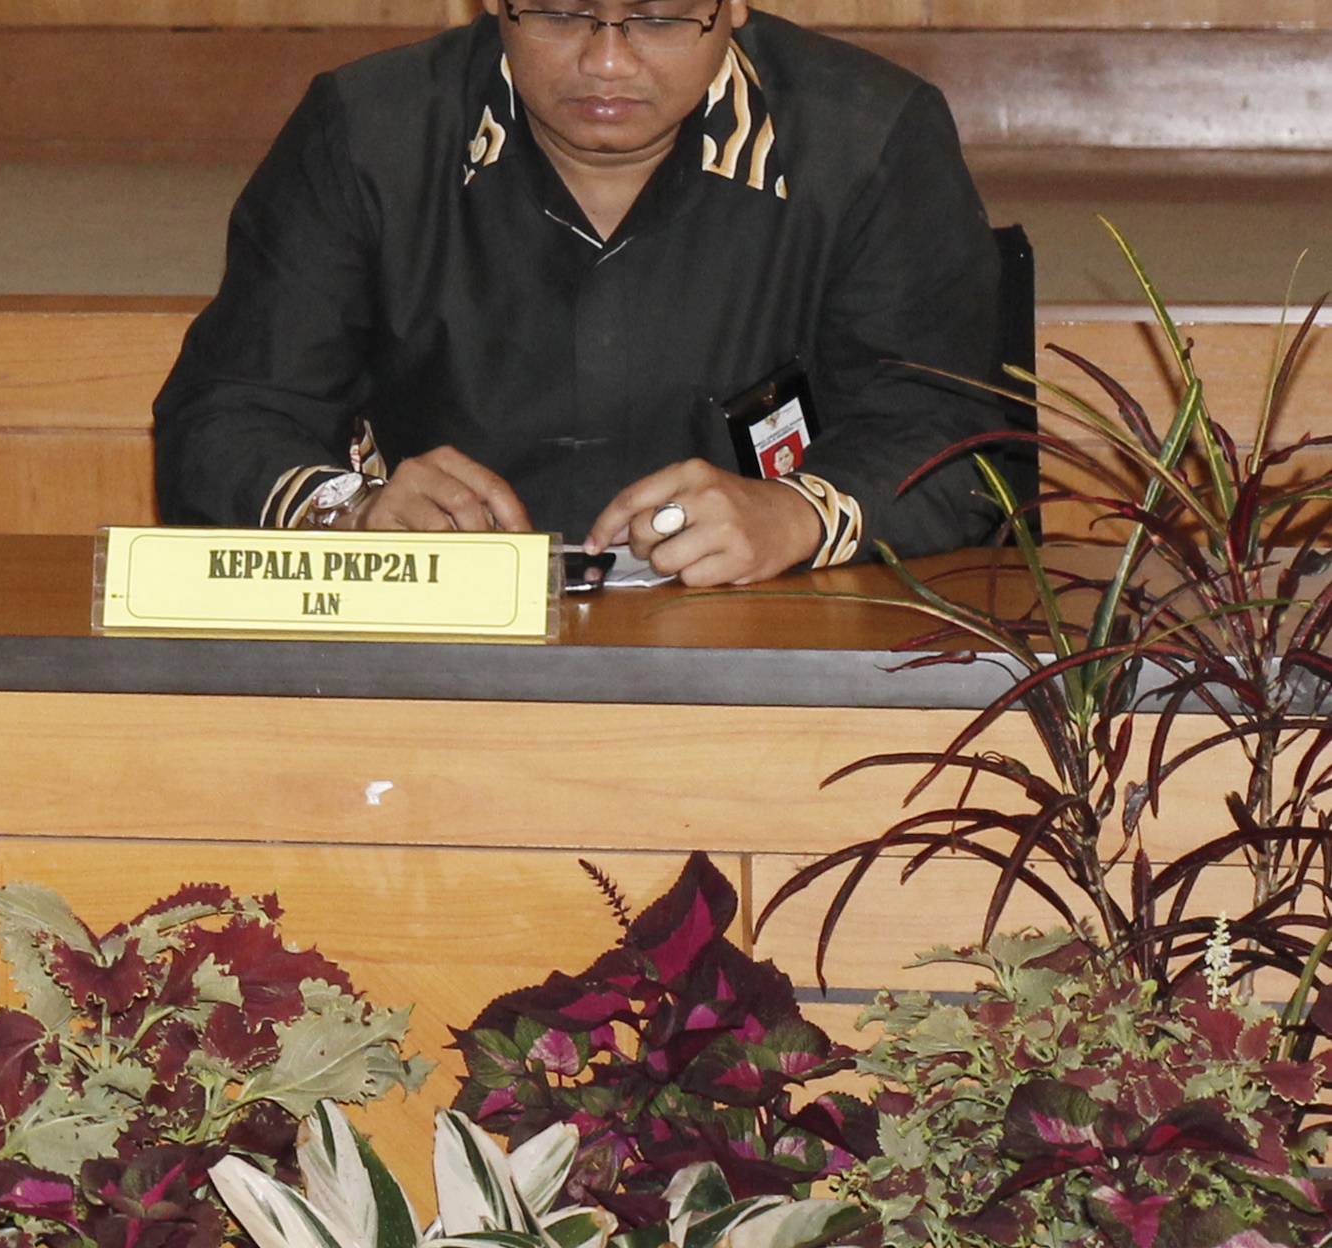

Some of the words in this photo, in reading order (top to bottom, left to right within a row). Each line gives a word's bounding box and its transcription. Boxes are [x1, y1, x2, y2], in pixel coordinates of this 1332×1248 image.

[208, 550, 313, 581] KEPALA
[322, 552, 418, 583] PKP2A
[427, 553, 440, 584] I
[302, 592, 341, 616] LAN
